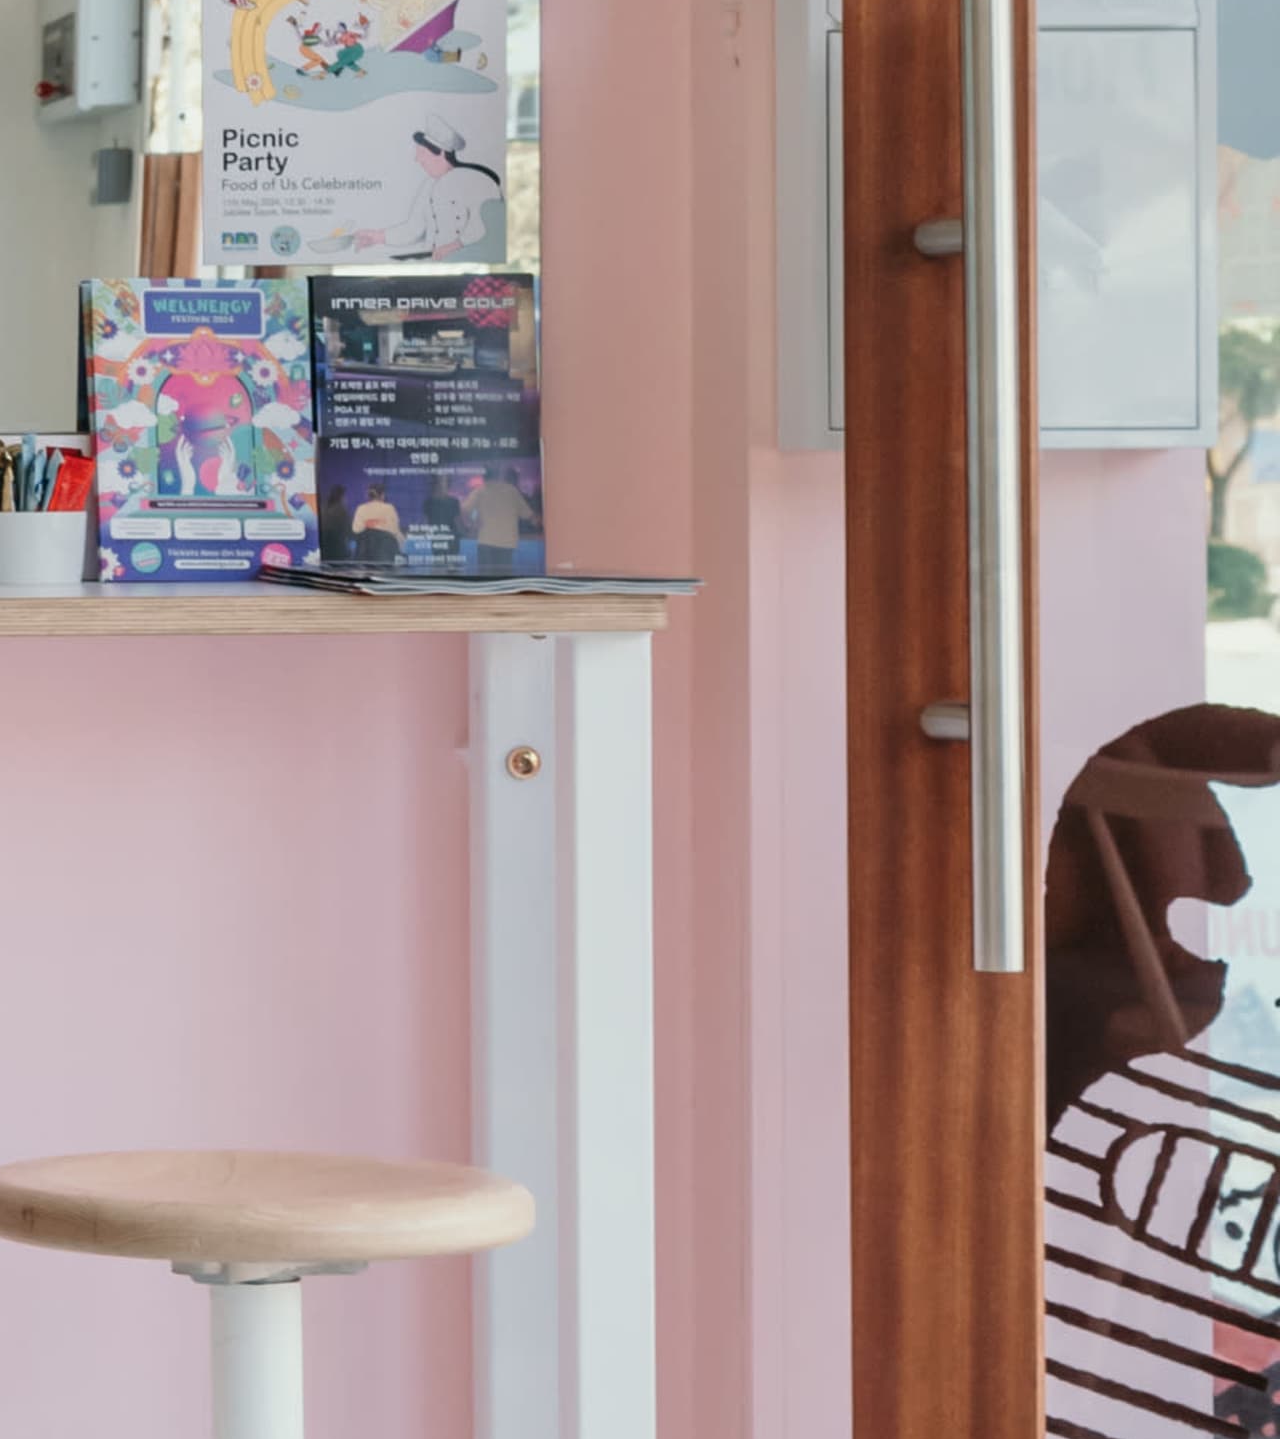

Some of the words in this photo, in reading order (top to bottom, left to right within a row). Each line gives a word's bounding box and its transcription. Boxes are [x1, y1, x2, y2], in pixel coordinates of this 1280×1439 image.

[222, 127, 300, 149] Picnic
[222, 151, 289, 176] Party
[221, 178, 258, 192] Food
[261, 178, 277, 191] of
[280, 178, 299, 191] Us
[301, 176, 384, 191] Celebration
[152, 298, 254, 315] WELLNERGY
